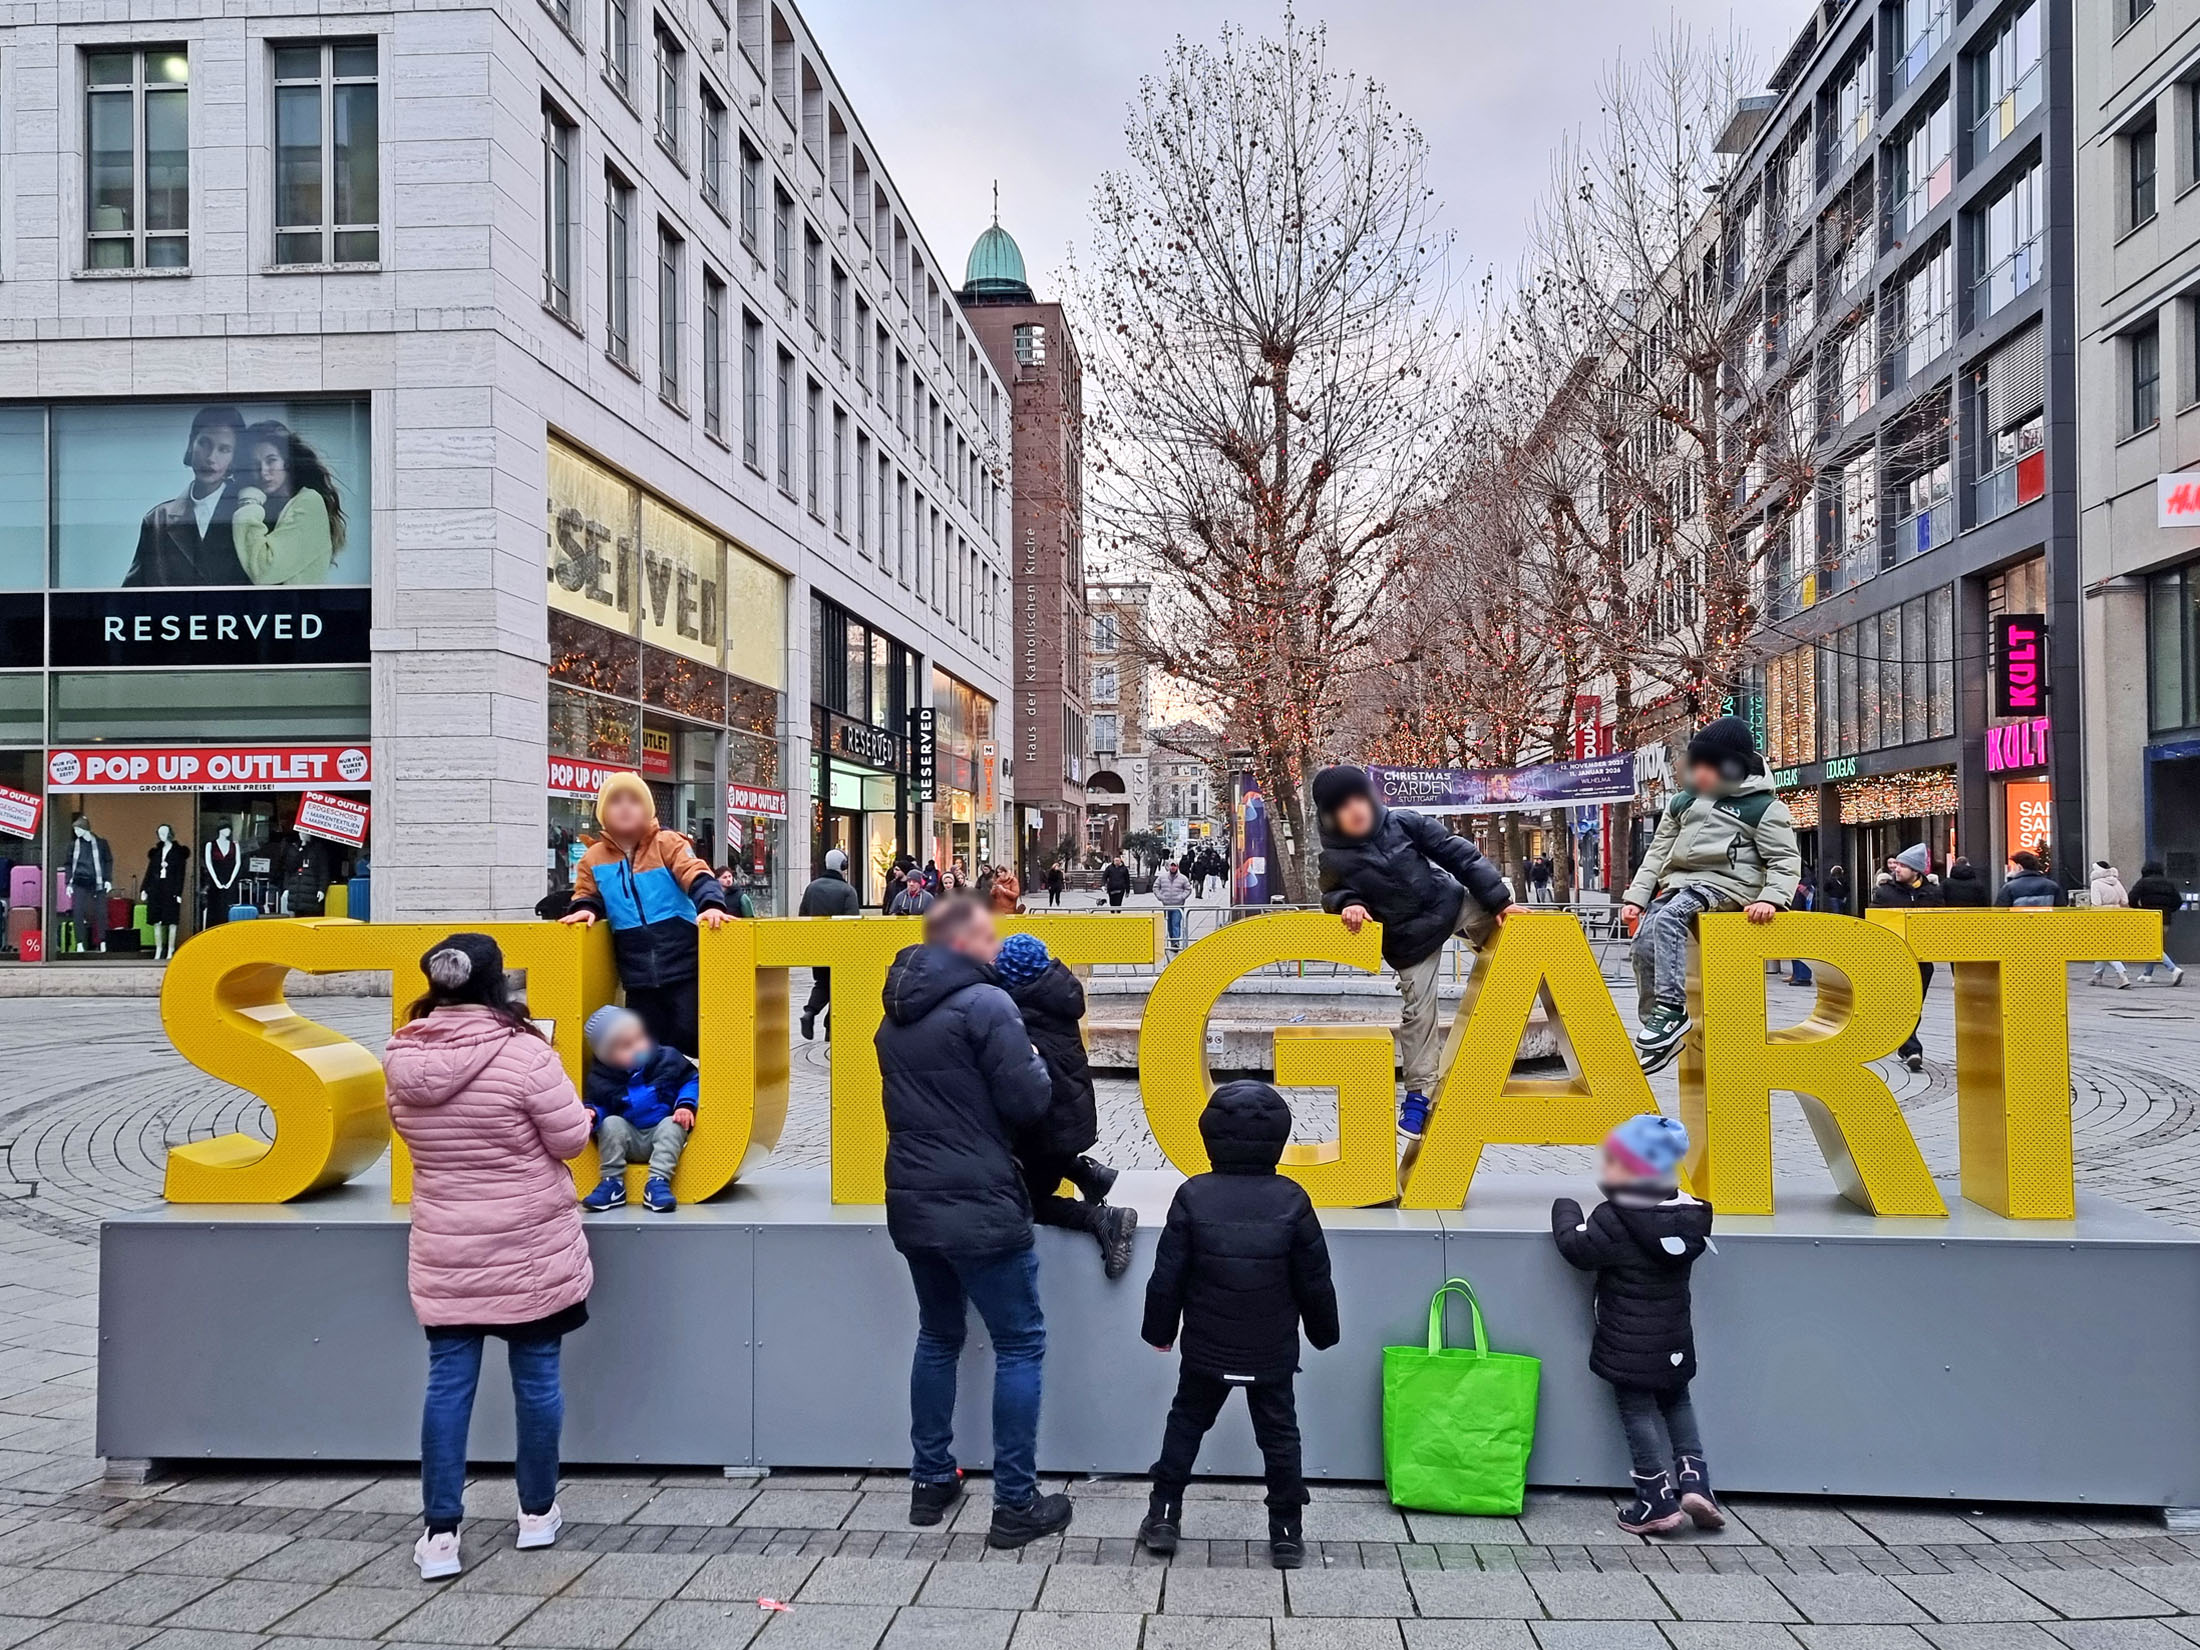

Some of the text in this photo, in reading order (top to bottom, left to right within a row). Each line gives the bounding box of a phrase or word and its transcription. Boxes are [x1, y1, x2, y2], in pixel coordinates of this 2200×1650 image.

[104, 614, 323, 642] RESERVED
[1025, 528, 1036, 761] Haus der Katholischen Kirche
[2008, 624, 2037, 707] KULT
[642, 732, 668, 751] UTLET
[847, 726, 894, 762] RESERVED
[1987, 718, 2049, 772] KULT
[920, 709, 932, 800] RESERVED
[1569, 761, 1607, 770] NOVEMBER
[86, 754, 328, 780] POP UP OUTLET
[551, 763, 574, 787] POP
[575, 767, 590, 788] UP
[1384, 771, 1452, 780] CHRISTMAS
[1774, 768, 1798, 788] DOUGLAS
[1826, 757, 1856, 779] DOUGLAS
[1132, 763, 1145, 806] ONLY
[1383, 781, 1453, 796] GARDEN
[9, 791, 40, 806] OUTLET
[306, 791, 369, 813] POP UP OUTLET
[735, 789, 749, 808] POP
[749, 792, 758, 809] UP
[758, 793, 780, 812] OUTLET
[1398, 795, 1438, 803] STUTTGART
[307, 803, 358, 821] ERDGESCHOSS
[160, 905, 2163, 1222] SUTGART
